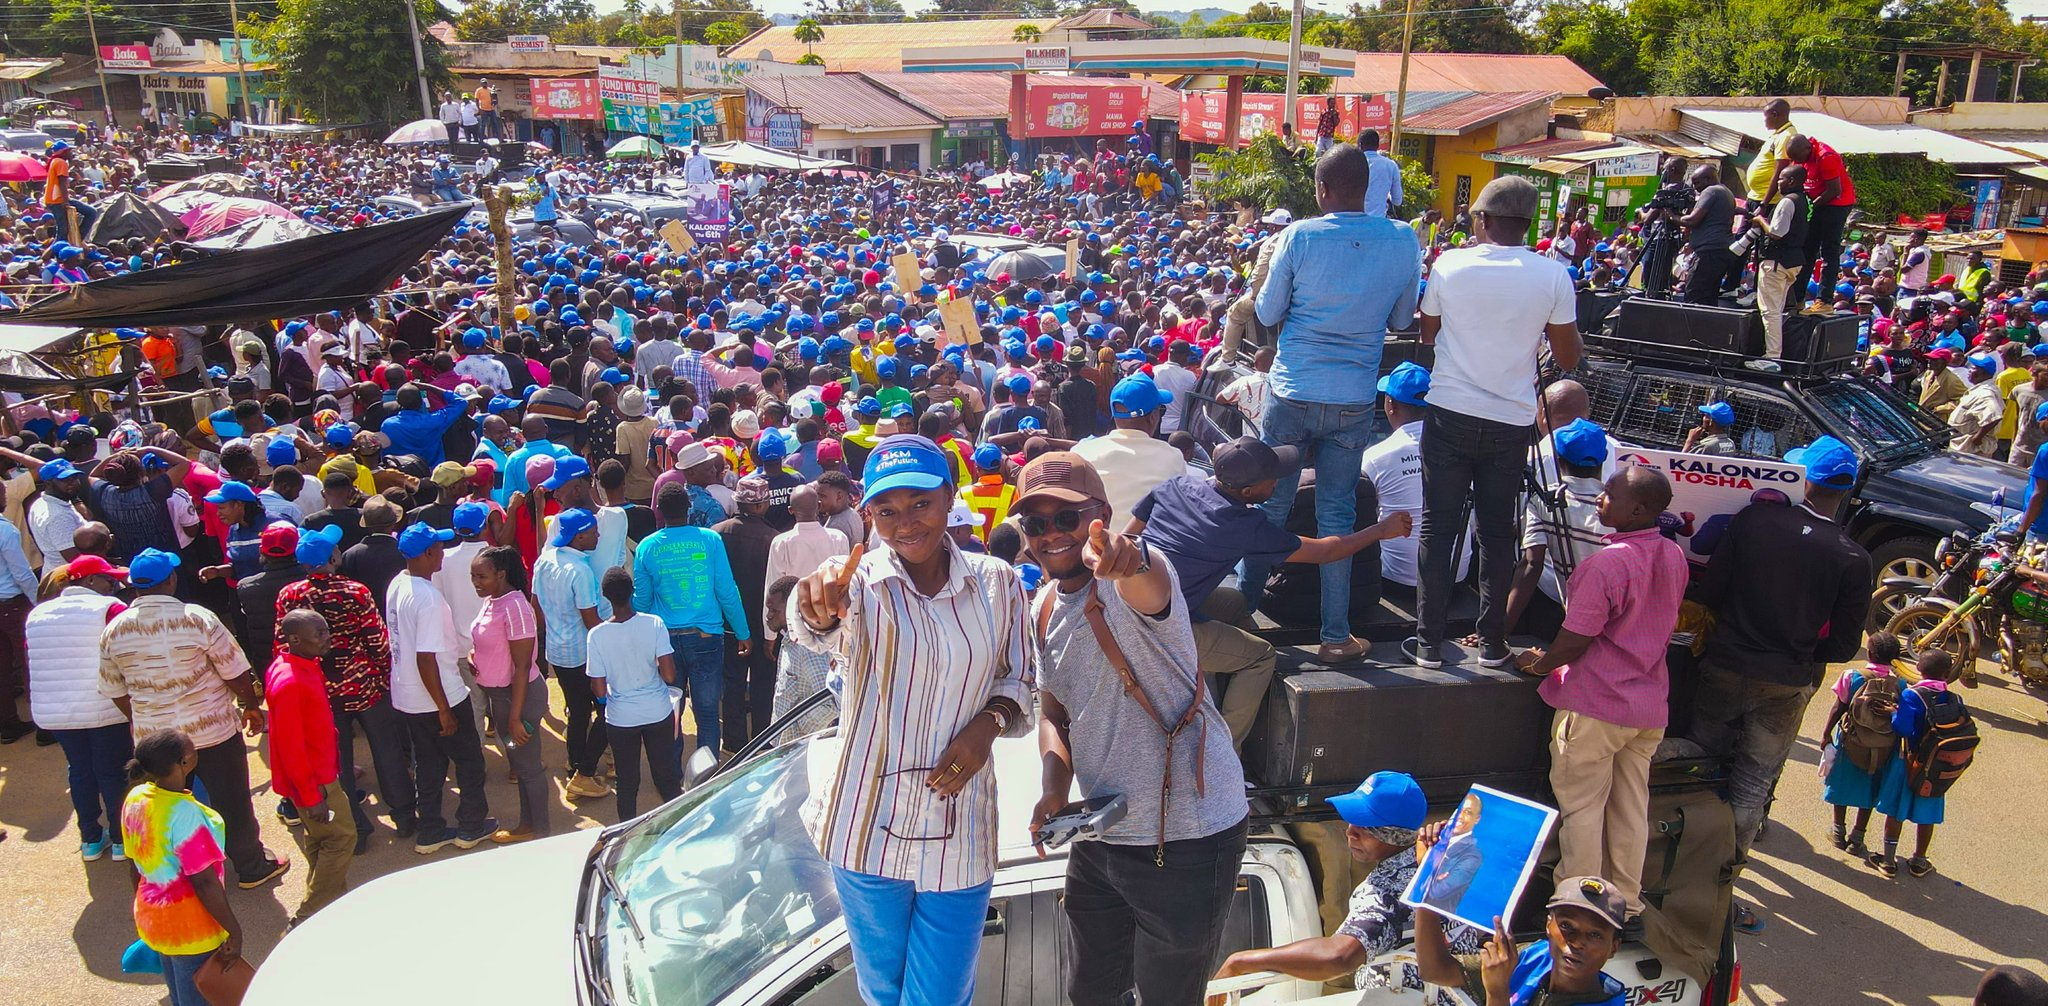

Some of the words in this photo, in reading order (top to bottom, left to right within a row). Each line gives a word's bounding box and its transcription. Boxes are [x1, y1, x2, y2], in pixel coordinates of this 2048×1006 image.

[510, 41, 545, 49] CHEMIST
[113, 46, 138, 60] Bata
[1025, 49, 1066, 58] BILKHEIR
[143, 75, 169, 88] Bata
[177, 76, 206, 89] Bata
[601, 79, 624, 91] FUNDI
[625, 81, 637, 92] WA
[638, 83, 658, 95] SIMU
[1304, 103, 1320, 111] DOLA
[1113, 121, 1127, 129] SHOP
[771, 130, 798, 138] Petrol
[771, 138, 799, 147] Station
[1402, 467, 1421, 476] KWA
[1669, 458, 1800, 483] KALONZO
[1670, 470, 1754, 491] TOSHA
[769, 487, 793, 498] ERVIC
[769, 496, 788, 506] REW
